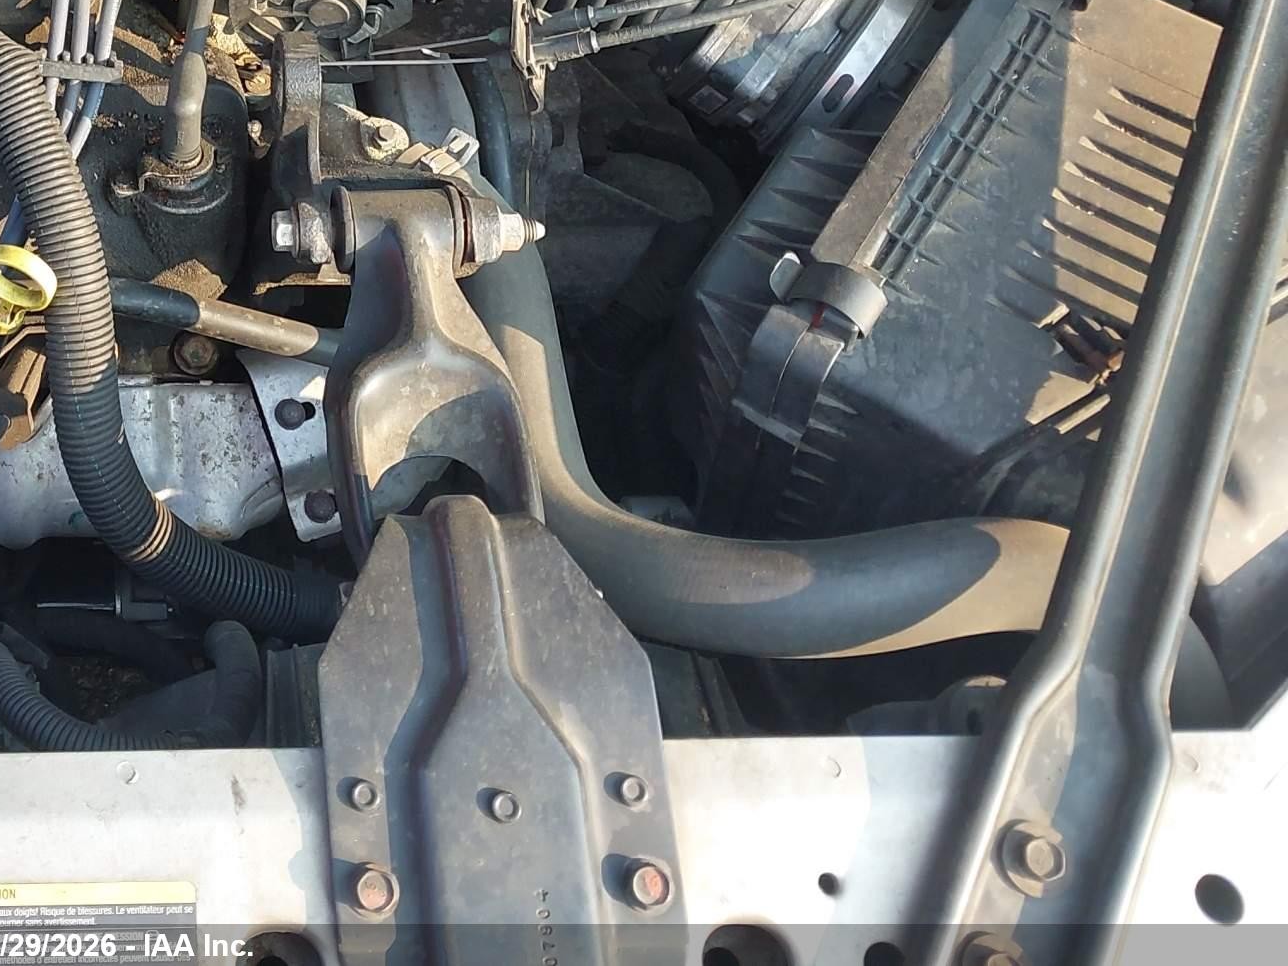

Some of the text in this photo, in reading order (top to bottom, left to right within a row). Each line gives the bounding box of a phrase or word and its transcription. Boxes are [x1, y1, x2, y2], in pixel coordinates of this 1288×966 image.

[14, 907, 39, 918] doigts!
[40, 907, 66, 918] Risque
[66, 906, 77, 916] de
[78, 906, 114, 916] blessures.
[115, 905, 125, 915] Le
[125, 905, 165, 915] ventilateur
[166, 905, 184, 916] peut
[184, 904, 194, 914] se
[25, 918, 43, 926] sans
[43, 917, 96, 926] avertissement.
